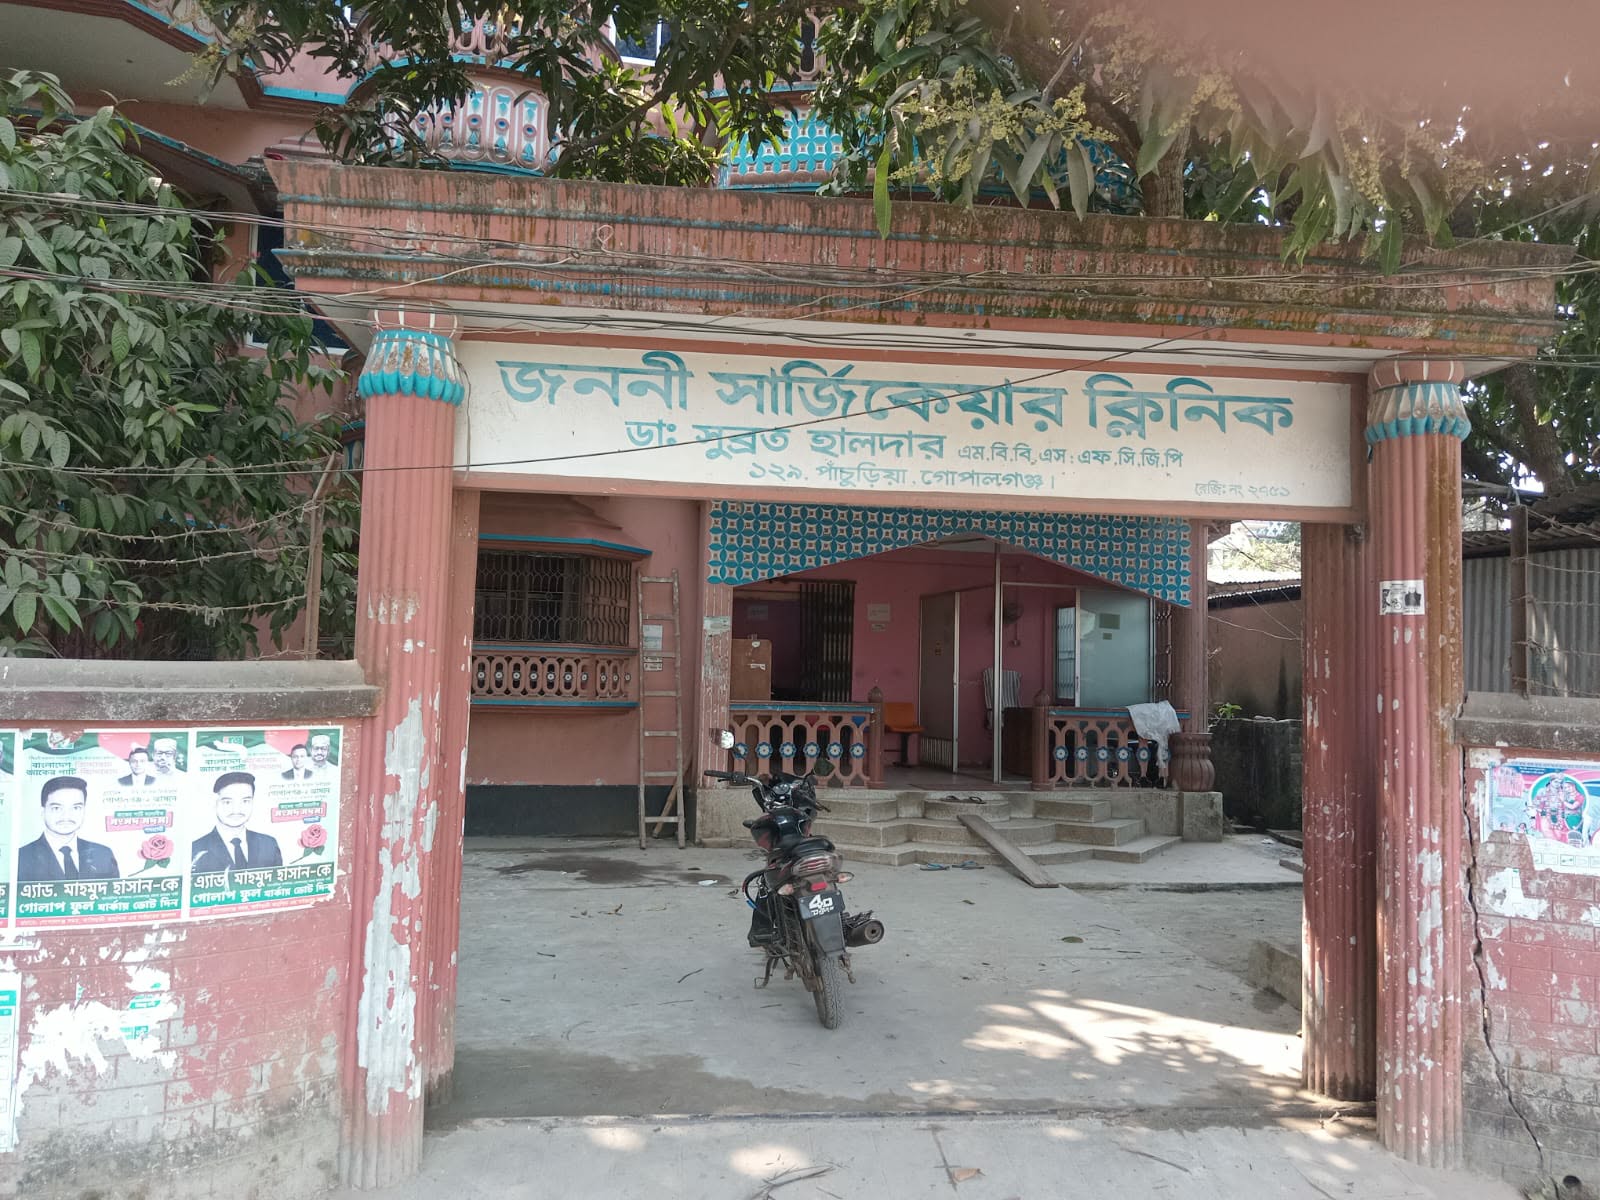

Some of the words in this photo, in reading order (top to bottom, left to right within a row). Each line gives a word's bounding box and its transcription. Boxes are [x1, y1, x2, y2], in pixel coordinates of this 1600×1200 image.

[496, 350, 695, 411] জননী
[708, 359, 1069, 433] সার্জিকেয়ার
[1082, 373, 1295, 441] ক্লিনিক
[692, 423, 791, 460] সুব্রত
[807, 425, 947, 461] হালদার
[235, 870, 273, 888] মাহমুদ
[277, 863, 332, 881] হাসান-কে
[64, 881, 107, 900] মাহমুদ
[113, 878, 179, 895] হাসান-কে
[240, 887, 261, 903] ফুল
[294, 883, 314, 894] ভোট
[19, 901, 65, 914] গোলাপ
[70, 900, 95, 915] ফুল
[133, 898, 157, 910] ভোট
[160, 896, 178, 908] দিন
